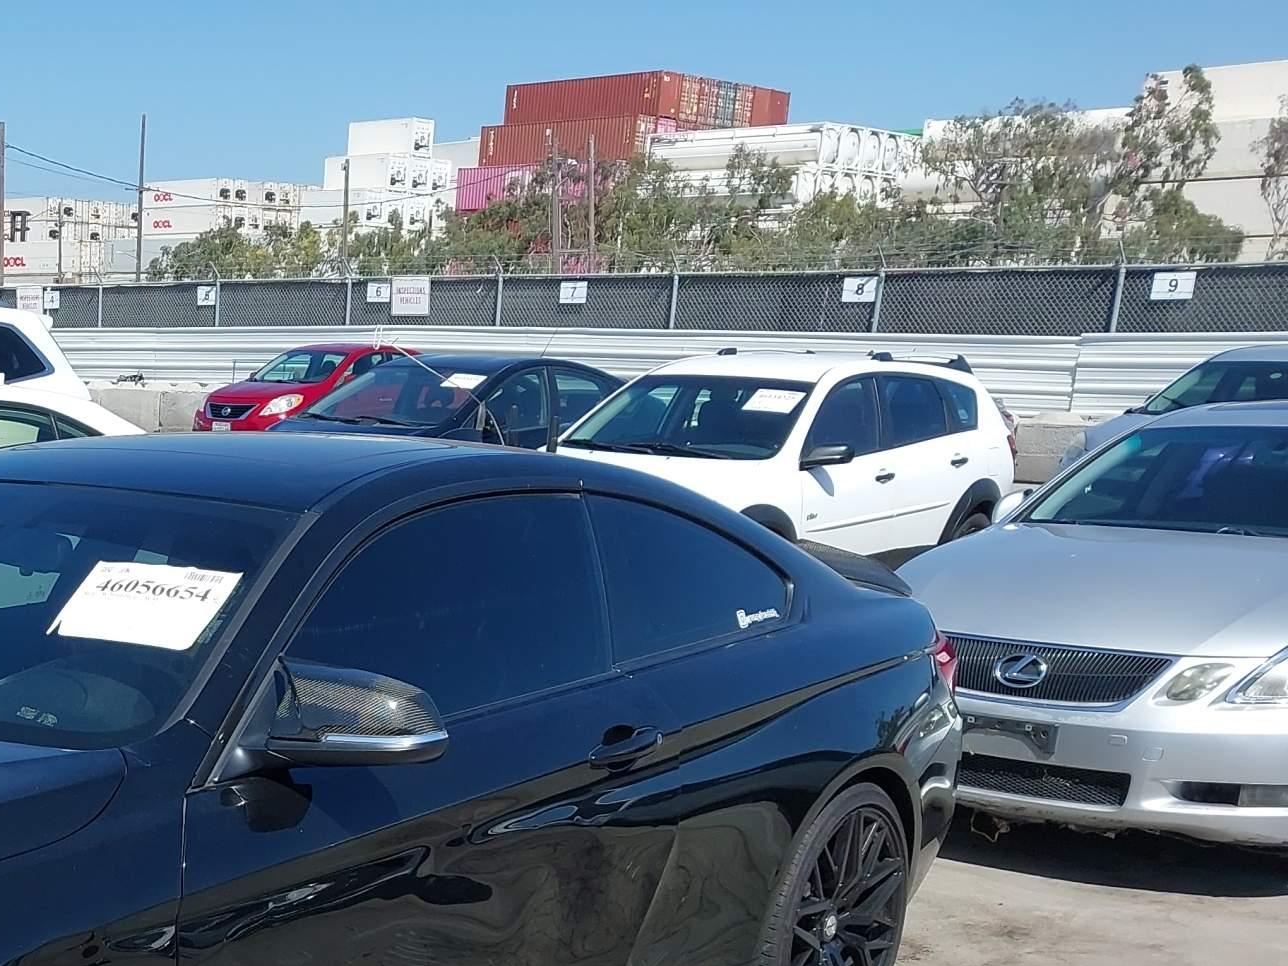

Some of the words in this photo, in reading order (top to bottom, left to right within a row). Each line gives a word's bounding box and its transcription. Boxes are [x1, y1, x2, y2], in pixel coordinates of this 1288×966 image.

[375, 286, 382, 297] 6
[570, 286, 577, 298] 7
[855, 282, 865, 296] 8
[1168, 278, 1179, 292] 9
[95, 578, 212, 602] 46056654
